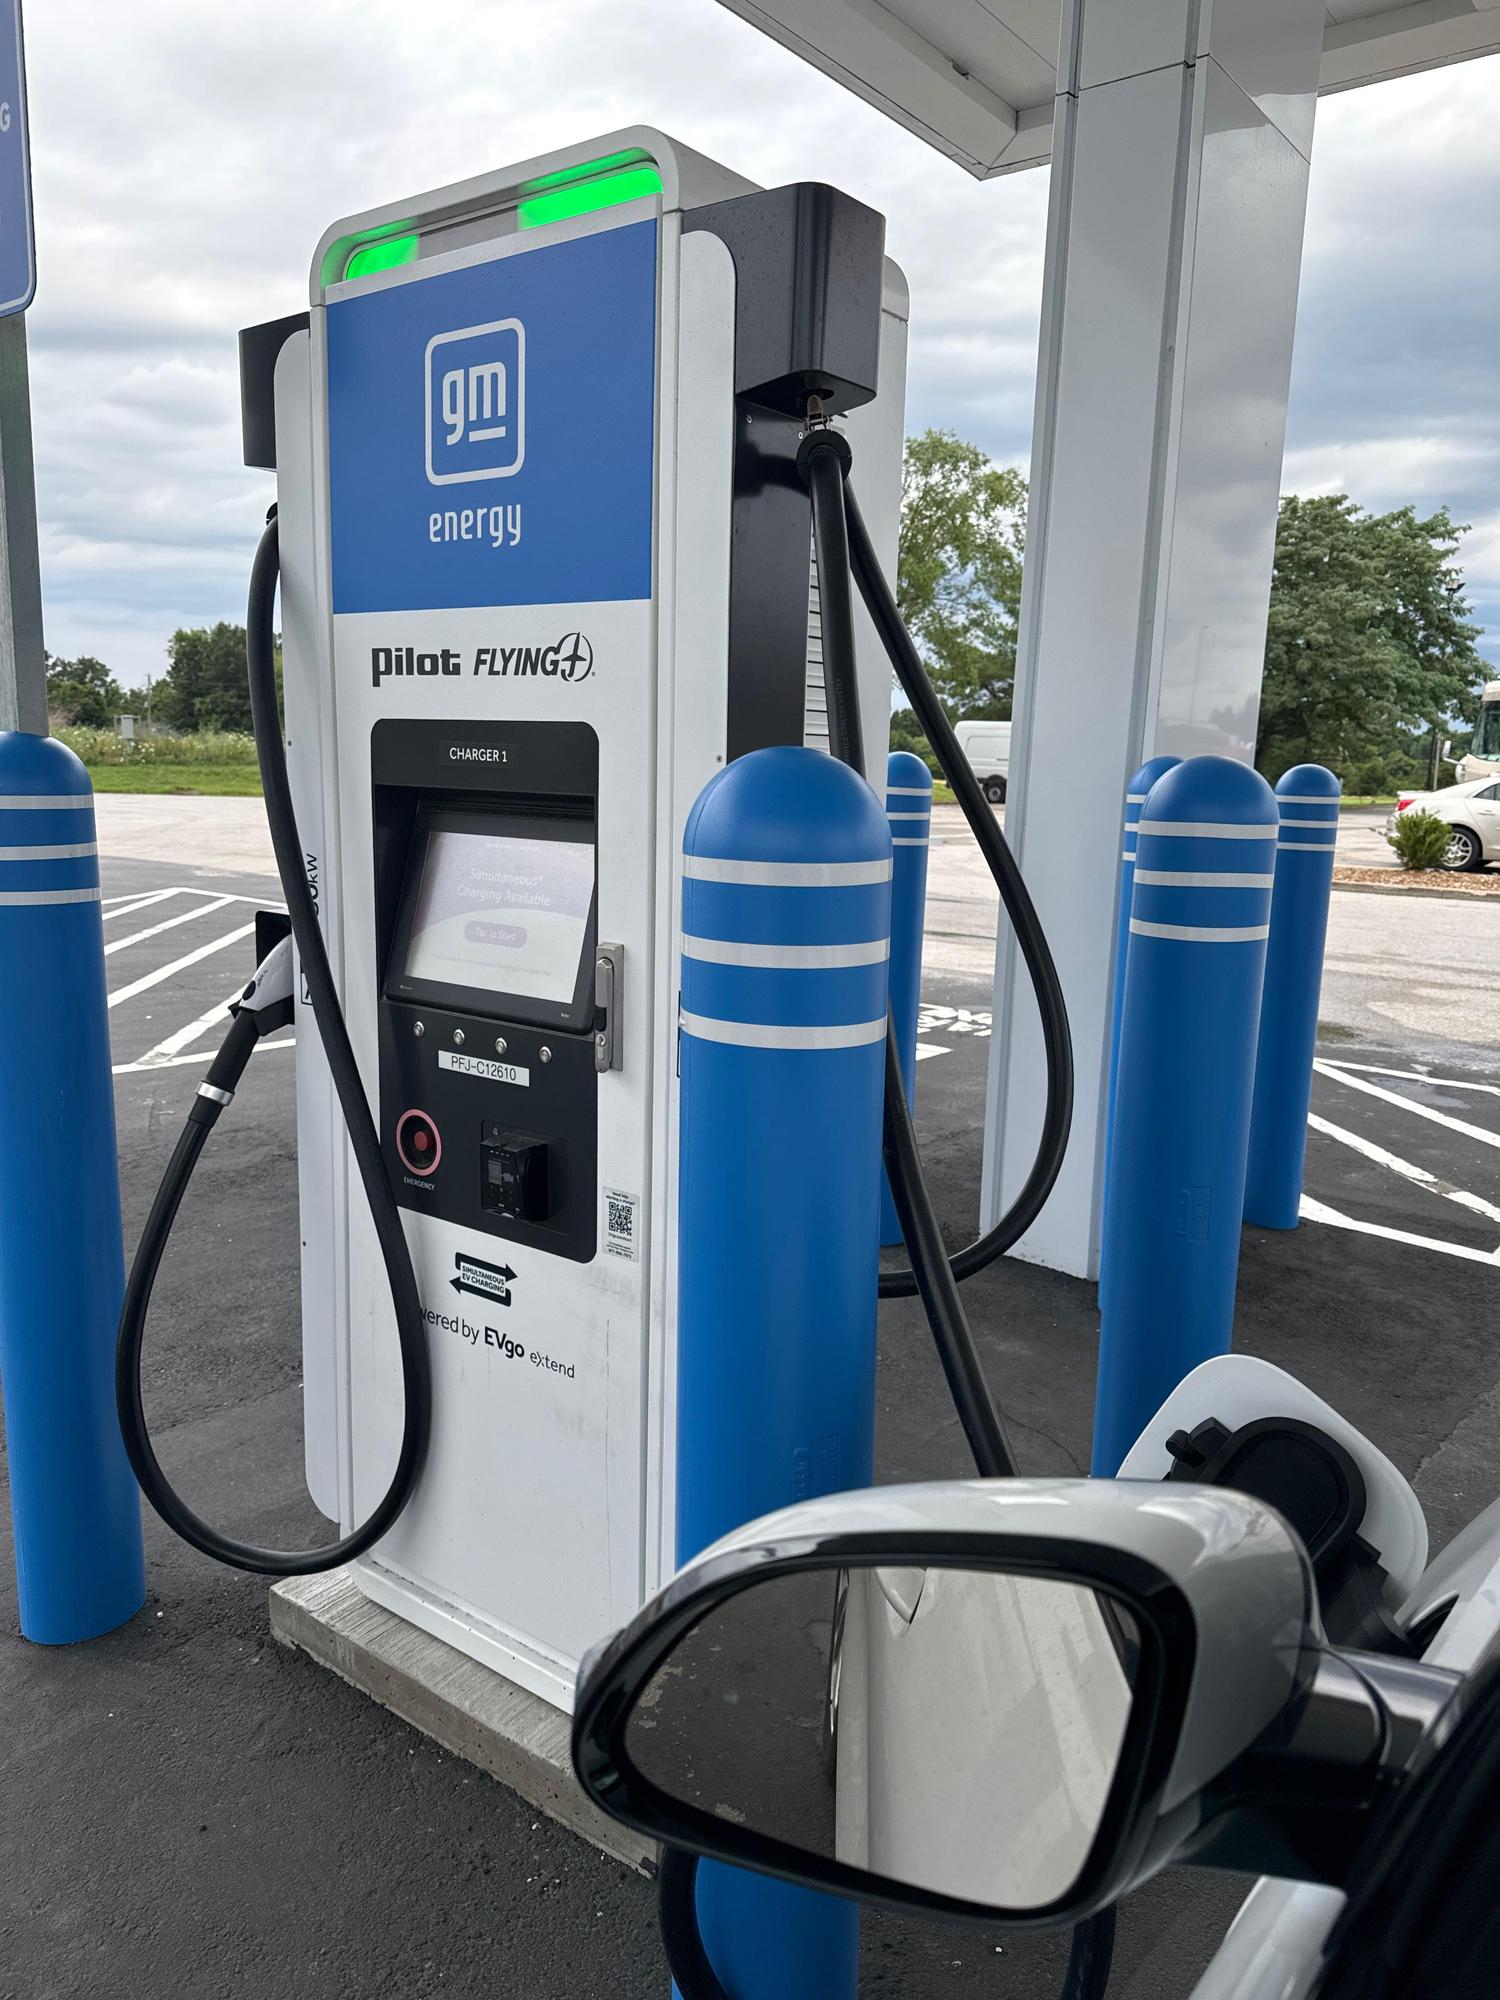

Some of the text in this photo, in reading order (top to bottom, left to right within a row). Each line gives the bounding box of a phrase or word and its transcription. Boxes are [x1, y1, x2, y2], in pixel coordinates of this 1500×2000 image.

[442, 361, 507, 446] gm
[429, 503, 521, 547] energy
[449, 747, 508, 763] CHARGER 1
[456, 883, 551, 907] Charging Available
[451, 1055, 517, 1081] PFJ-C12610
[403, 1176, 436, 1191] EMERGENCY
[462, 1265, 505, 1286] SIMULTANEOUS
[462, 1272, 505, 1294] EV CHARGING
[461, 1317, 480, 1345] by
[484, 1326, 526, 1359] EVgo
[529, 1351, 575, 1379] extend
